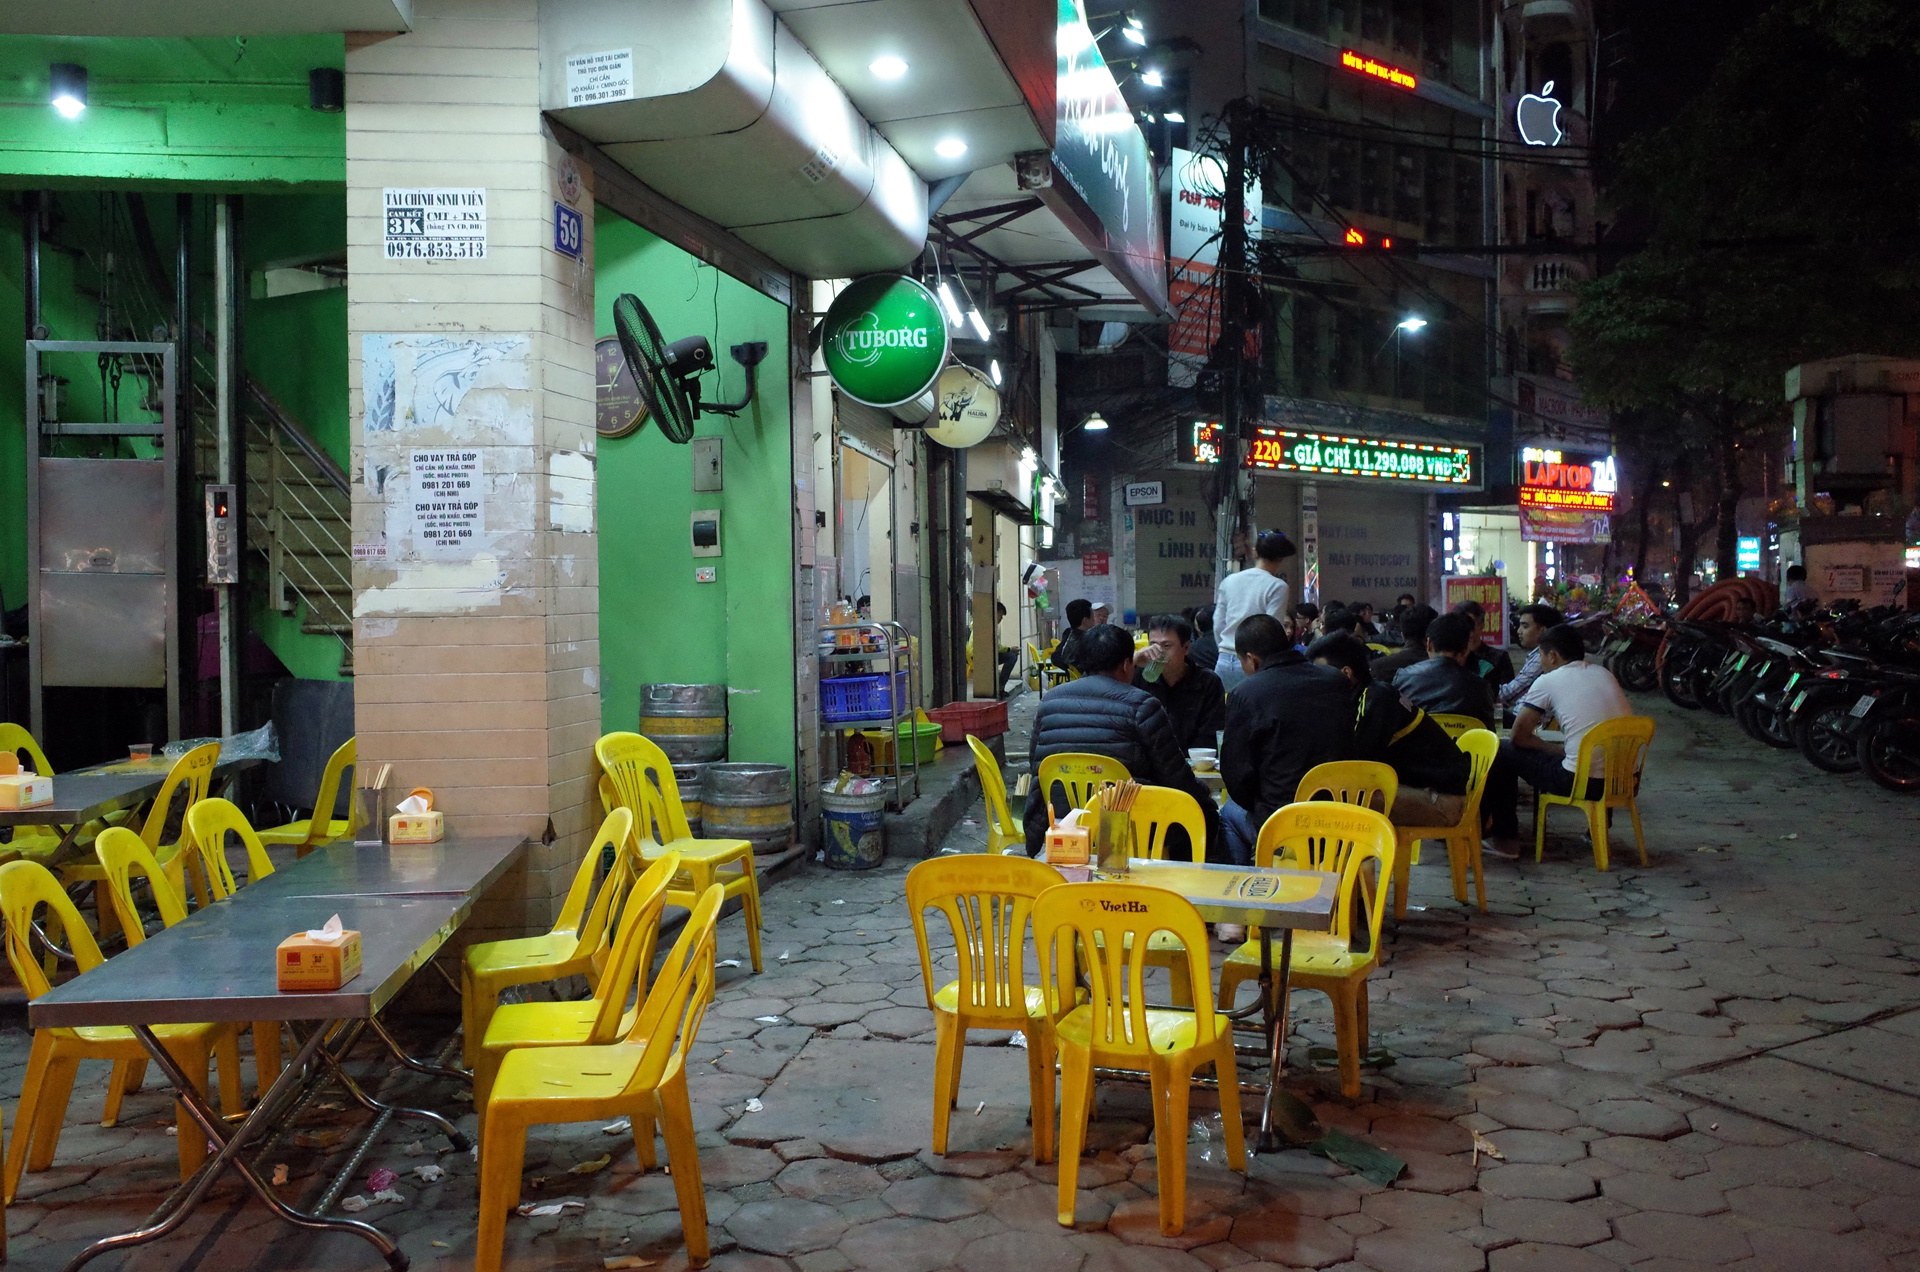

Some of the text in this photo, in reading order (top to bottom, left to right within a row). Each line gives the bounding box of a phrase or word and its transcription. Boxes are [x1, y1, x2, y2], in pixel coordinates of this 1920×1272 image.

[585, 89, 626, 101] 096.301.3993
[385, 190, 484, 206] TÀI CHÍNH SINH VIÊN
[1179, 189, 1202, 206] FUJI
[407, 209, 422, 217] KẾT
[427, 212, 450, 221] CMT
[389, 218, 422, 234] 3K
[560, 211, 579, 250] 59
[1179, 218, 1189, 228] Đại
[1190, 221, 1196, 231] lý
[1198, 223, 1208, 232] bán
[387, 242, 484, 258] 0976.853.513
[846, 327, 928, 350] TUBORG
[608, 348, 617, 356] 12
[611, 416, 617, 425] 6
[624, 410, 631, 418] 5
[414, 454, 428, 463] CHO
[446, 451, 461, 462] TRẢ
[462, 453, 477, 462] GÓP
[1254, 440, 1281, 461] 220
[1294, 440, 1322, 466] GIÁ
[1525, 460, 1592, 488] LAPTOP
[422, 481, 440, 489] 0981
[441, 481, 455, 489] 201
[1130, 486, 1158, 498] EPSON
[415, 503, 430, 511] CHO
[448, 500, 462, 511] TRẢ
[464, 502, 479, 510] GÓP
[1138, 510, 1174, 528] MỰC
[423, 530, 442, 539] 0981
[443, 530, 456, 538] 201
[1355, 552, 1411, 566] PHOTOCOPY
[1180, 571, 1210, 588] MÁY
